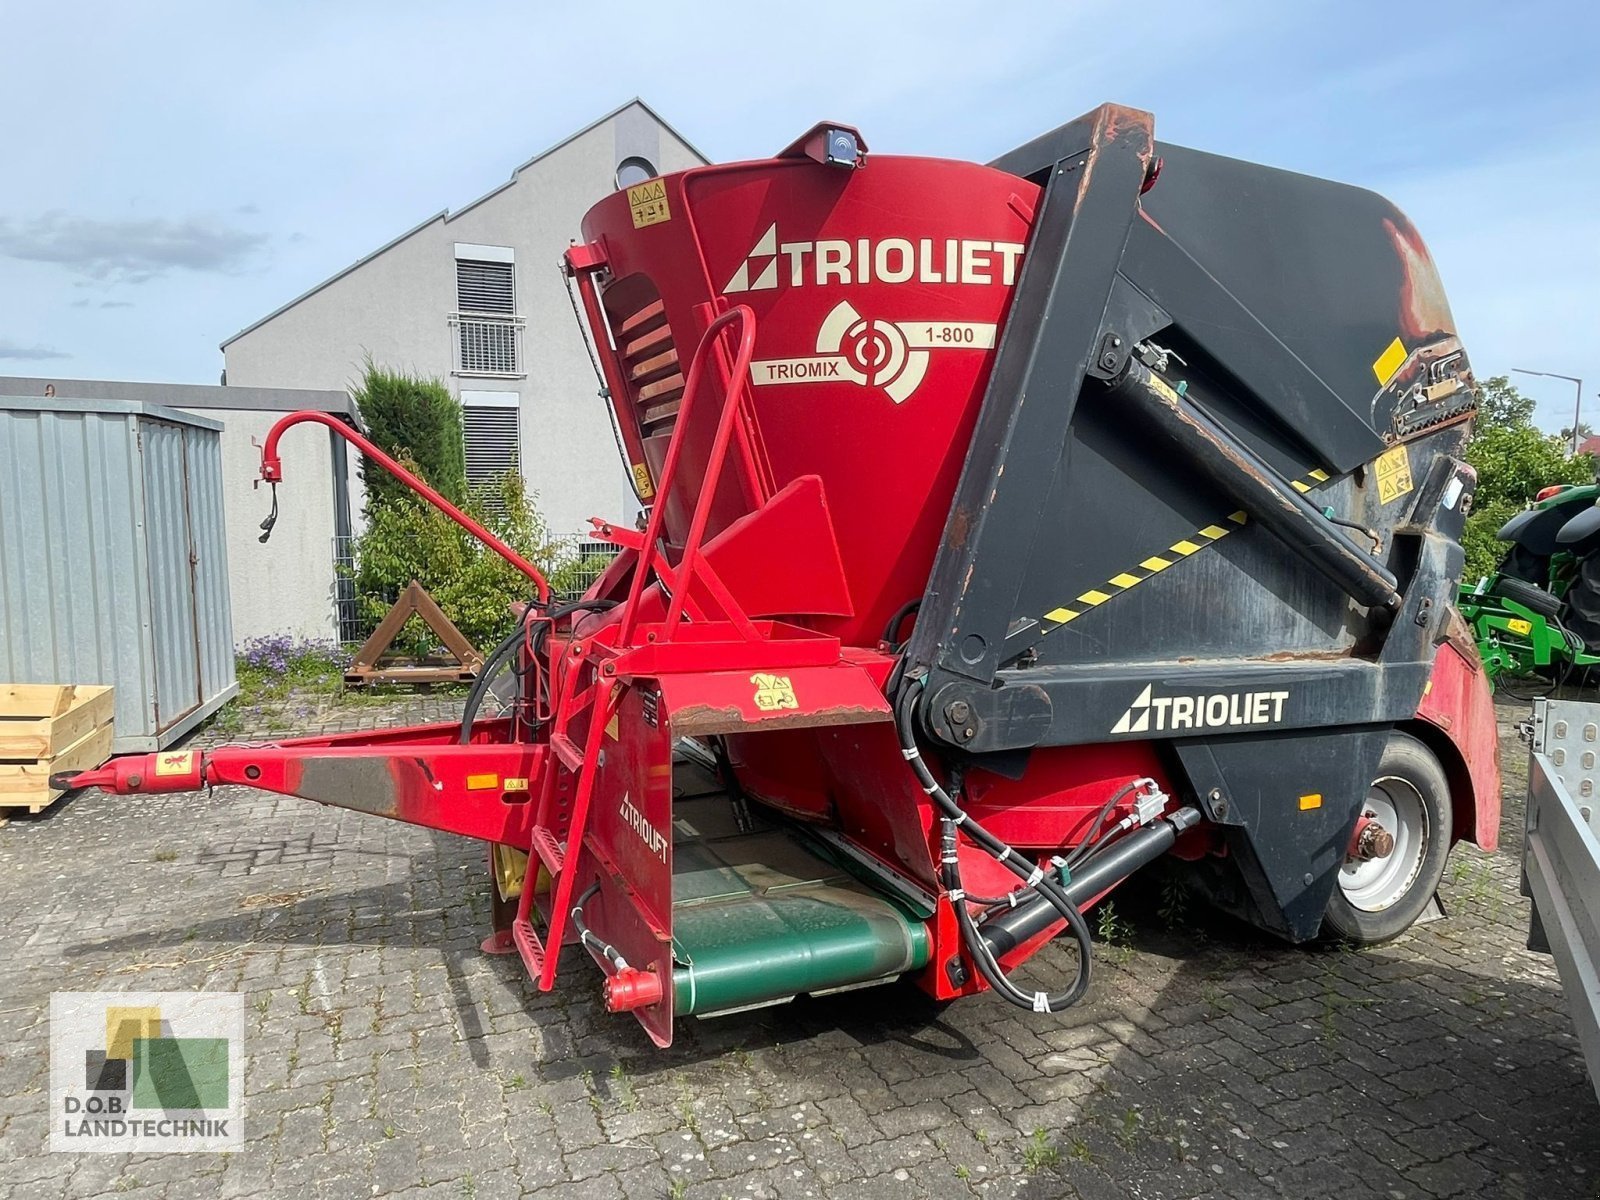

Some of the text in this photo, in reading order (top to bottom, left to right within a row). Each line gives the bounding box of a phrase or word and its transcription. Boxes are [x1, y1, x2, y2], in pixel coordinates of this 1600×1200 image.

[781, 238, 1025, 287] TRIOLIET
[925, 328, 974, 343] 1-800
[766, 361, 840, 380] TRIOMIX
[1152, 691, 1289, 731] TRIOLIET
